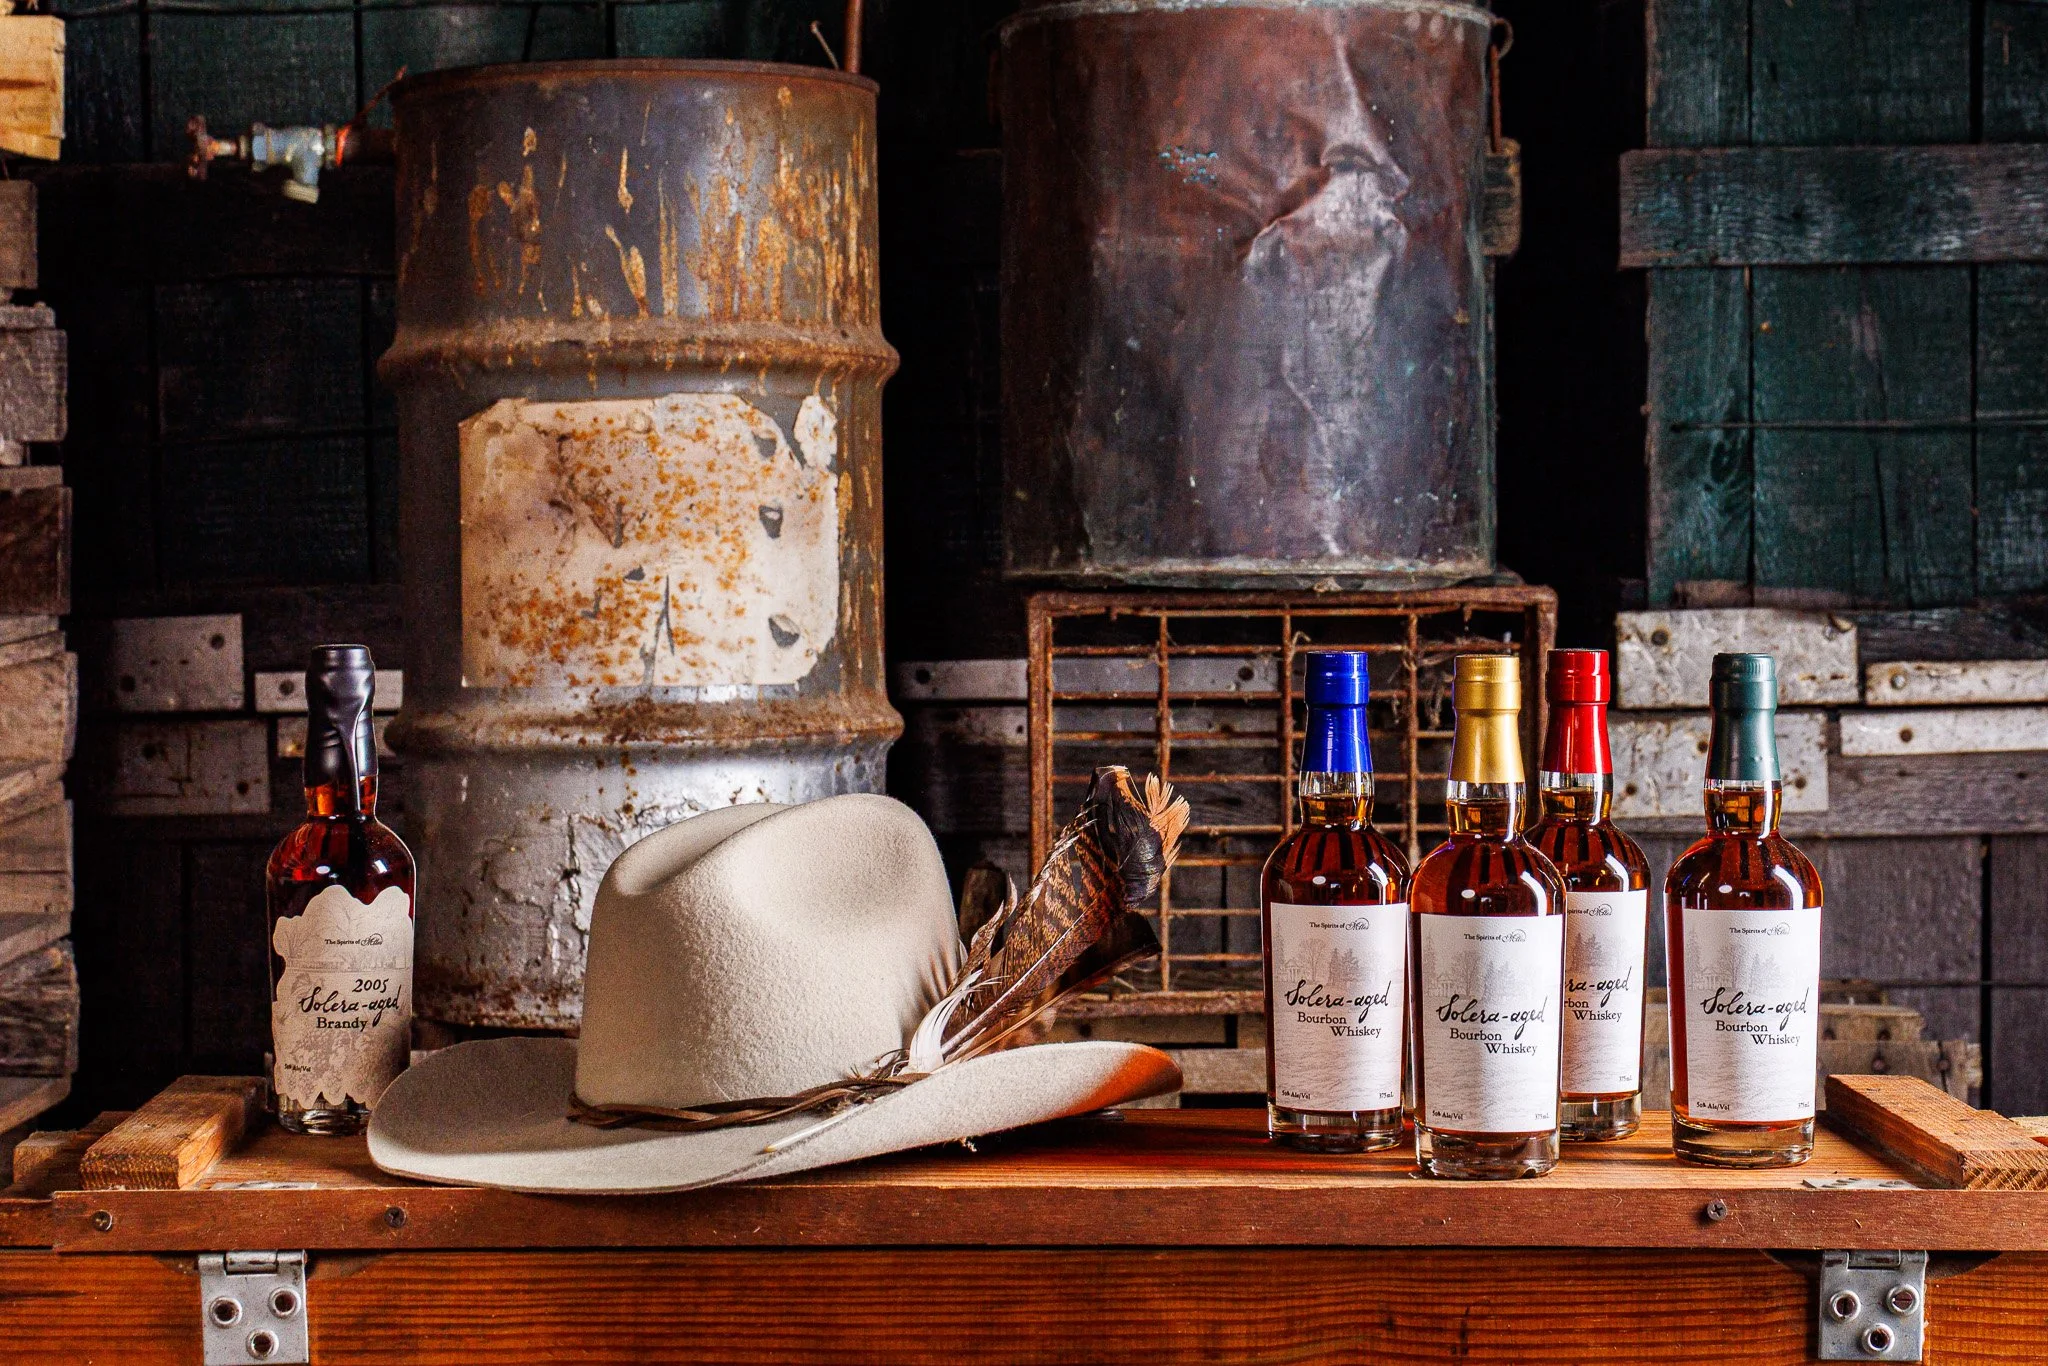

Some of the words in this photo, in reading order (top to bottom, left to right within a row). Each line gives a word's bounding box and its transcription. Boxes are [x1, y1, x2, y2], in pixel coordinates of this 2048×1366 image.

[1309, 921, 1320, 929] The
[1320, 922, 1339, 930] Spirits
[324, 938, 337, 946] The
[337, 938, 354, 947] Spirits
[1463, 933, 1475, 941] The
[1476, 934, 1495, 942] Spirits
[352, 978, 389, 993] 2005
[1565, 966, 1632, 1008] ra-aged
[298, 984, 403, 1028] Solera-aged
[1284, 979, 1391, 1023] Solera-aged
[1564, 998, 1589, 1009] rbon
[1573, 1009, 1622, 1022] Whiskey
[1700, 986, 1809, 1031] Solera-aged
[316, 1016, 368, 1032] Brandy
[1297, 1011, 1347, 1025] Bourbon
[1436, 994, 1548, 1040] Solera-aged
[1330, 1025, 1382, 1039] Whiskey
[1715, 1020, 1768, 1032] Bourbon
[1450, 1028, 1502, 1041] Bourbon
[1751, 1033, 1801, 1047] Whiskey
[1484, 1042, 1538, 1056] Whiskey
